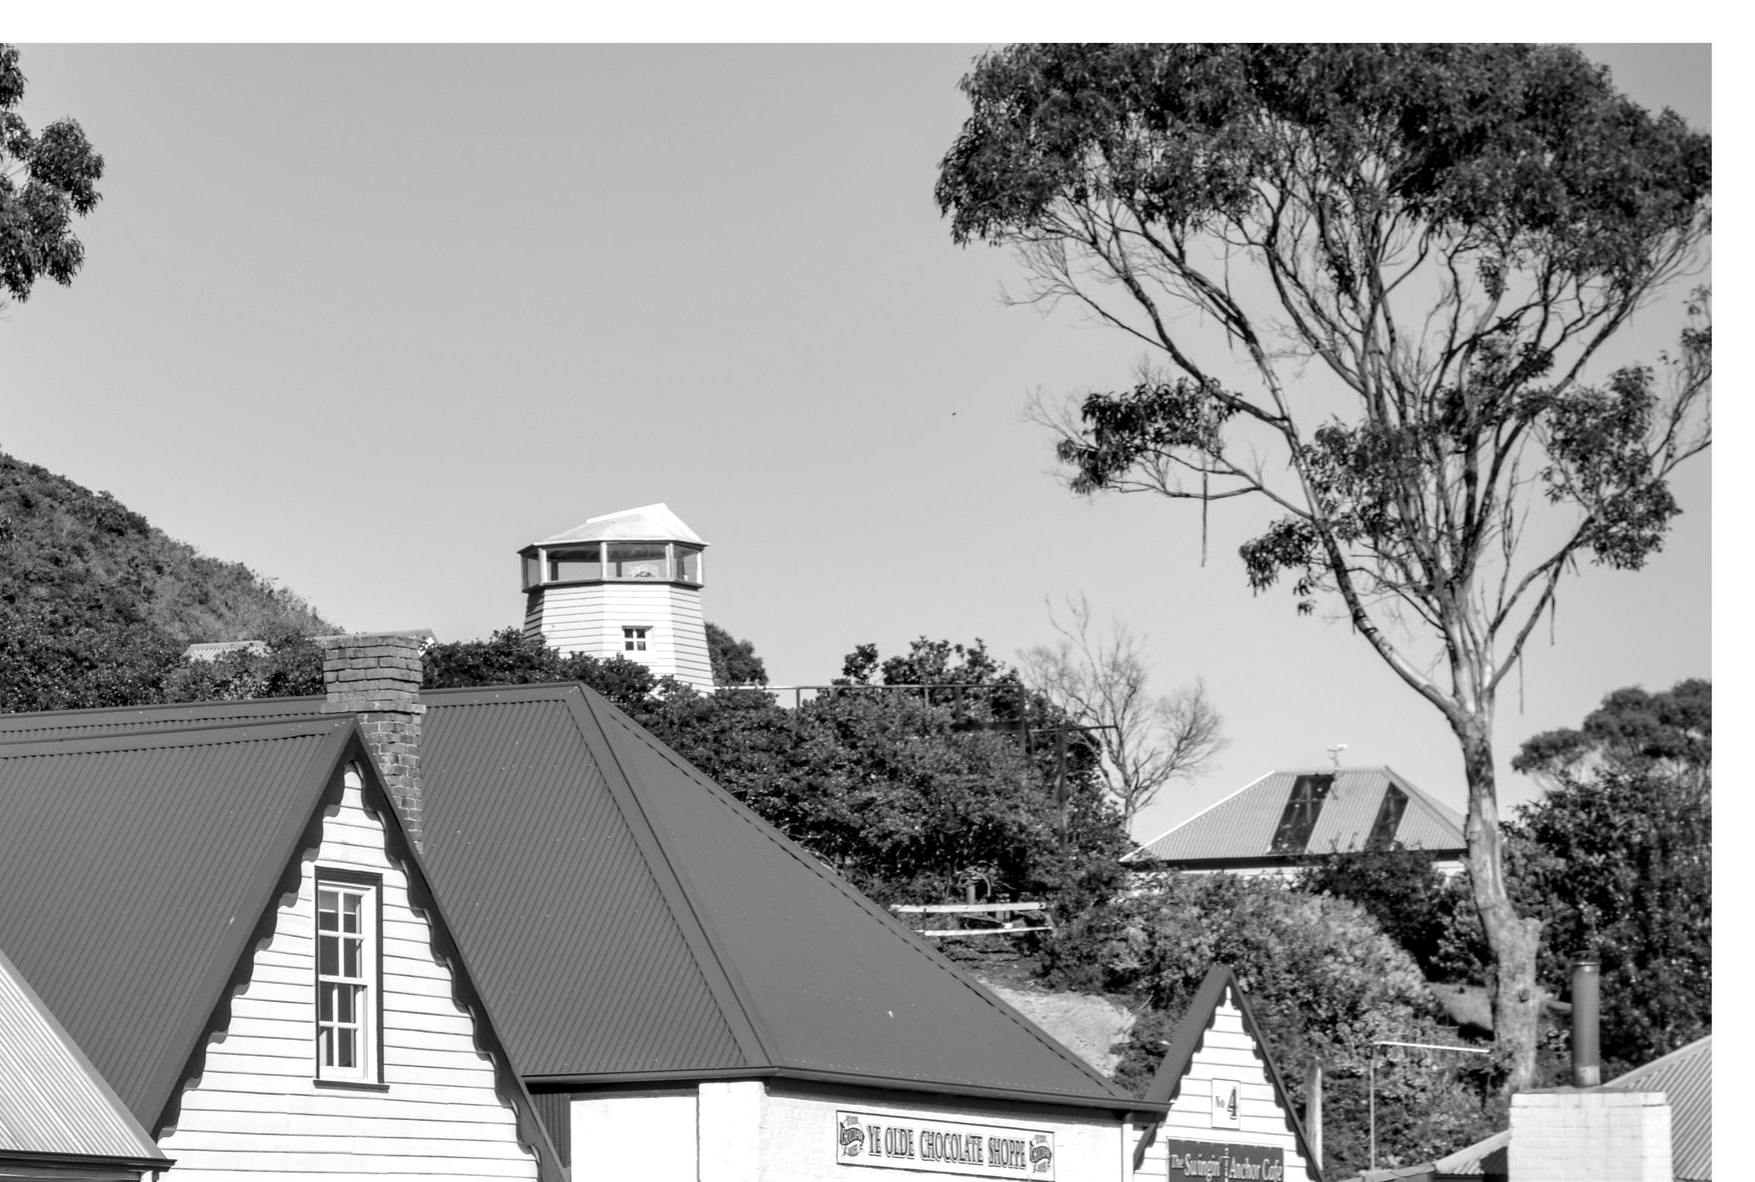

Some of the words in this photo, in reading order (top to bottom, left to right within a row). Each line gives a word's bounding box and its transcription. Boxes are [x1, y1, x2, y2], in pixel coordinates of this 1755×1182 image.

[1227, 1086, 1238, 1120] 4
[867, 1125, 882, 1156] YE
[885, 1127, 915, 1159] OLDE
[920, 1130, 984, 1165] CHOCOLATE
[988, 1137, 1027, 1168] SHOPPE
[1228, 1157, 1262, 1180] Anchor
